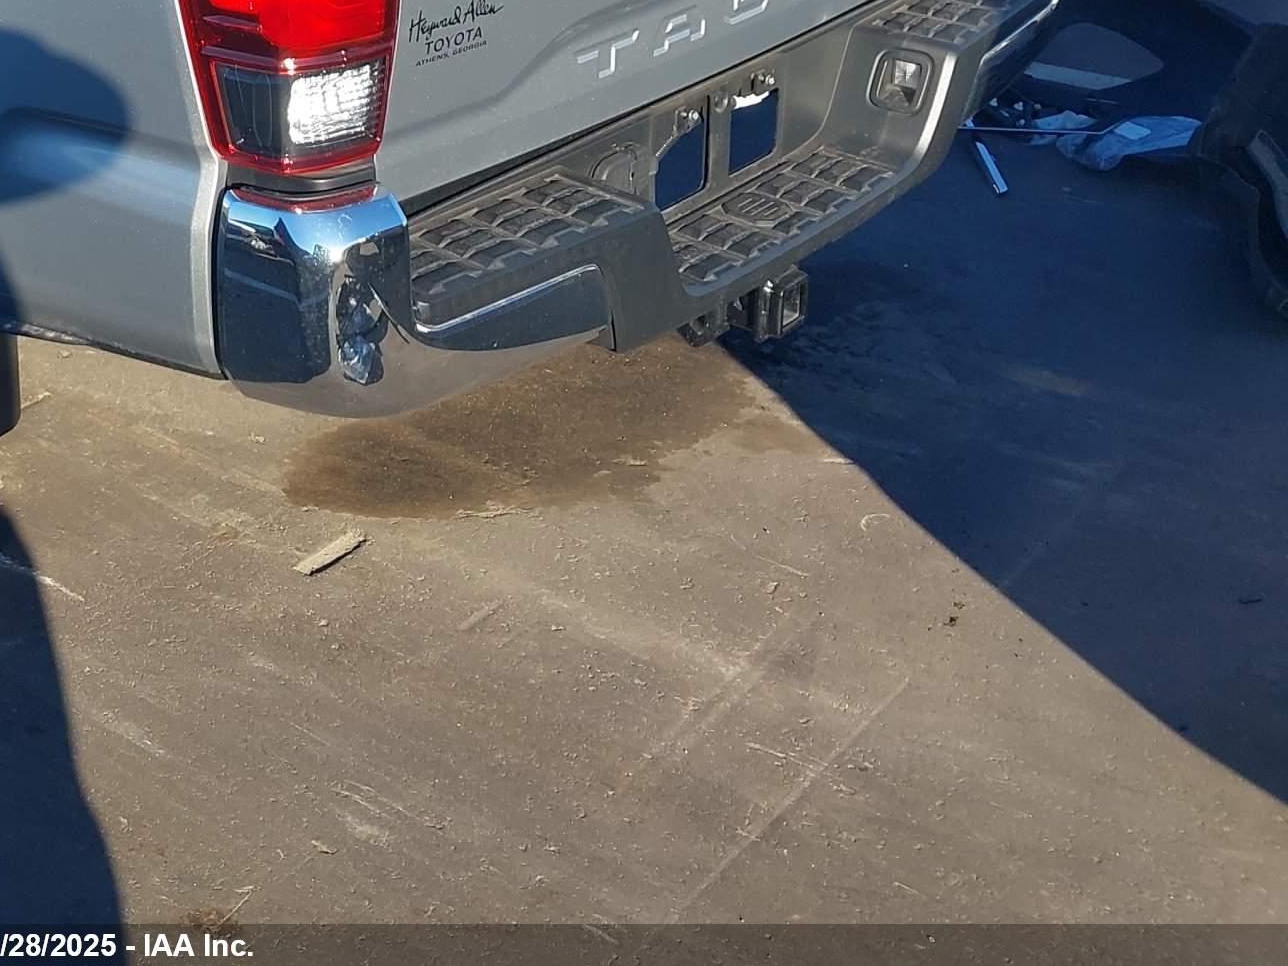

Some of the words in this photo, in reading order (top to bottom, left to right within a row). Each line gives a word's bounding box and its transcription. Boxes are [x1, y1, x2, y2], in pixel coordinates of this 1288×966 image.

[408, 5, 462, 43] Heyward
[415, 53, 450, 67] ATHENS,
[452, 40, 488, 56] GEORGIA
[425, 26, 483, 55] TOYOTA
